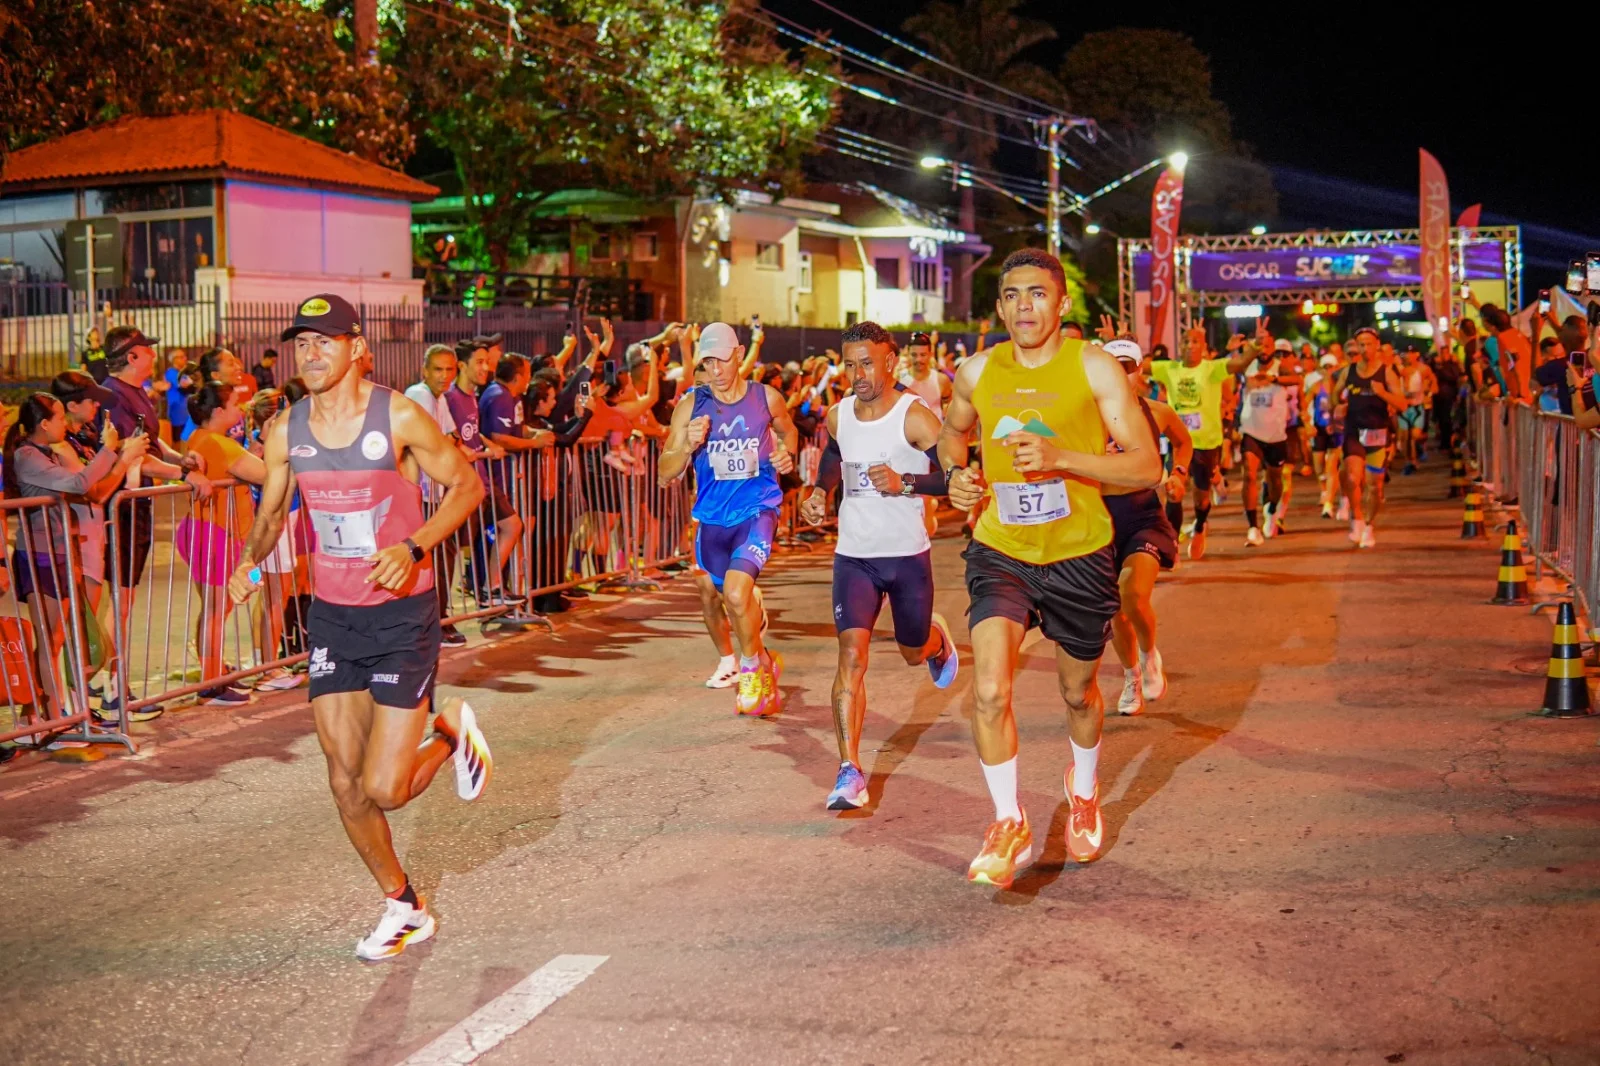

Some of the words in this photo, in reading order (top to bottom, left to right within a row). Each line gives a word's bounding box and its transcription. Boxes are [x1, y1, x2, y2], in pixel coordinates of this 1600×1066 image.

[1152, 189, 1176, 308] OSCAR
[1219, 262, 1280, 281] OSCAR
[706, 437, 760, 455] move
[727, 458, 746, 472] 80
[308, 487, 372, 500] EAGLES
[1018, 492, 1045, 514] 57
[333, 525, 343, 546] 1
